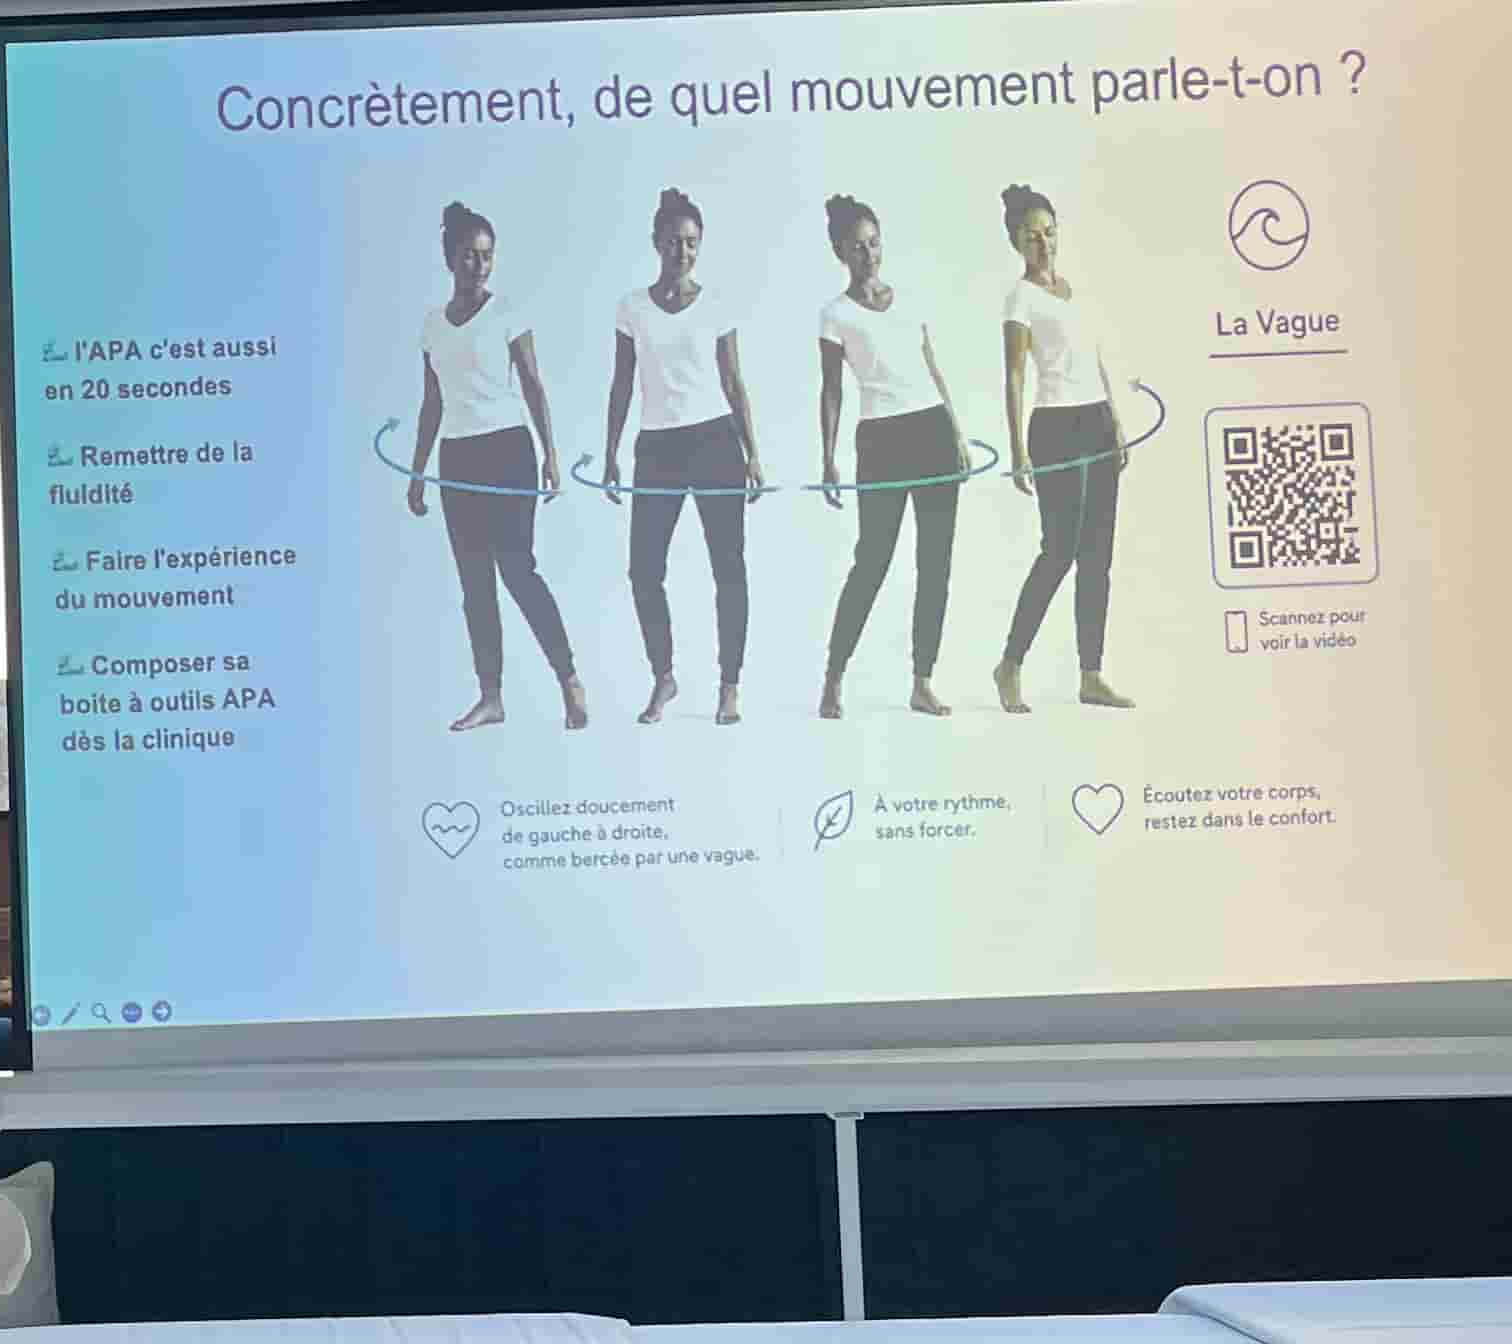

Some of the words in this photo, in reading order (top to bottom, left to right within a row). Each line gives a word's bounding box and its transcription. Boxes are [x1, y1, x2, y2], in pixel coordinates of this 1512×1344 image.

[217, 78, 575, 132] Concrètement,
[594, 73, 653, 119] de
[670, 69, 772, 128] quel
[791, 61, 1076, 113] mouvement
[1092, 55, 1321, 115] parle-t-on
[1339, 49, 1366, 95] ?
[1216, 311, 1249, 337] La
[1255, 309, 1340, 340] Vague
[75, 340, 143, 362] l'APA
[149, 338, 207, 360] c'est
[212, 335, 277, 358] aussi
[44, 382, 74, 401] en
[81, 378, 110, 400] 20
[117, 375, 232, 399] secondes
[80, 444, 188, 468] Remettre
[196, 441, 225, 463] de
[233, 439, 253, 463] la
[48, 481, 134, 505] fluidité
[86, 549, 147, 572] Faire
[153, 545, 297, 573] l'expérience
[55, 588, 86, 611] du
[93, 584, 235, 609] mouvement
[1259, 610, 1326, 627] Scannez
[1329, 610, 1366, 627] pour
[1259, 634, 1291, 651] voir
[1294, 633, 1309, 649] la
[1313, 631, 1357, 649] vidéo
[91, 655, 216, 680] Composer
[223, 655, 250, 671] sa
[128, 691, 143, 713] à
[150, 689, 216, 713] outils
[221, 687, 276, 710] APA
[61, 729, 107, 752] dès
[114, 727, 135, 751] la
[141, 727, 235, 753] clinique
[892, 797, 939, 813] votre
[1217, 786, 1264, 801] votre
[499, 799, 572, 817] Oscillez
[575, 797, 675, 815] doucement
[1144, 815, 1193, 831] restez
[1201, 811, 1244, 828] dans
[1247, 809, 1265, 827] le
[501, 827, 524, 844] de
[527, 825, 593, 846] gauche
[597, 823, 608, 841] à
[875, 825, 915, 841] sans
[503, 855, 567, 870] comme
[634, 851, 664, 869] par
[669, 850, 700, 865] une
